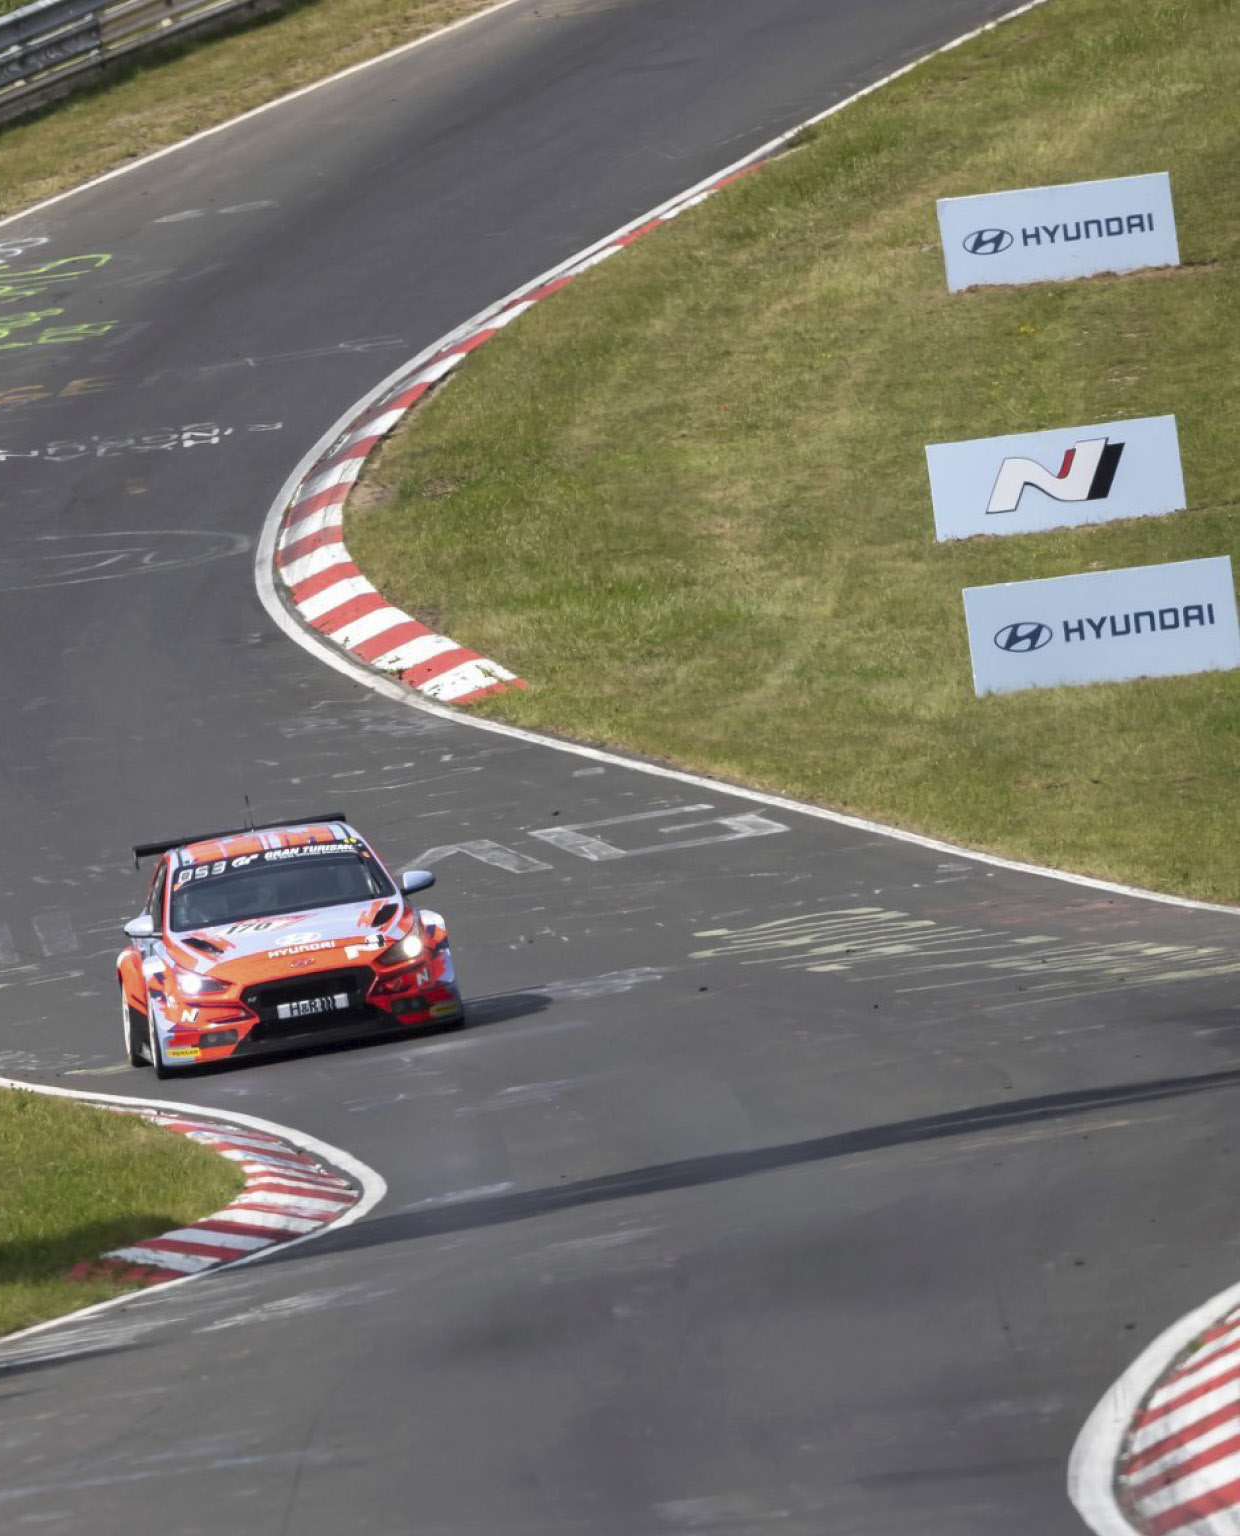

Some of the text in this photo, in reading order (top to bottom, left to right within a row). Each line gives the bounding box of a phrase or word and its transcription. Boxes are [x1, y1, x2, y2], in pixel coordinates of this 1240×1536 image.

[1022, 213, 1155, 246] HYUNDAI
[1063, 603, 1215, 642] HYUNDAI
[268, 940, 335, 959] HYUNDAI
